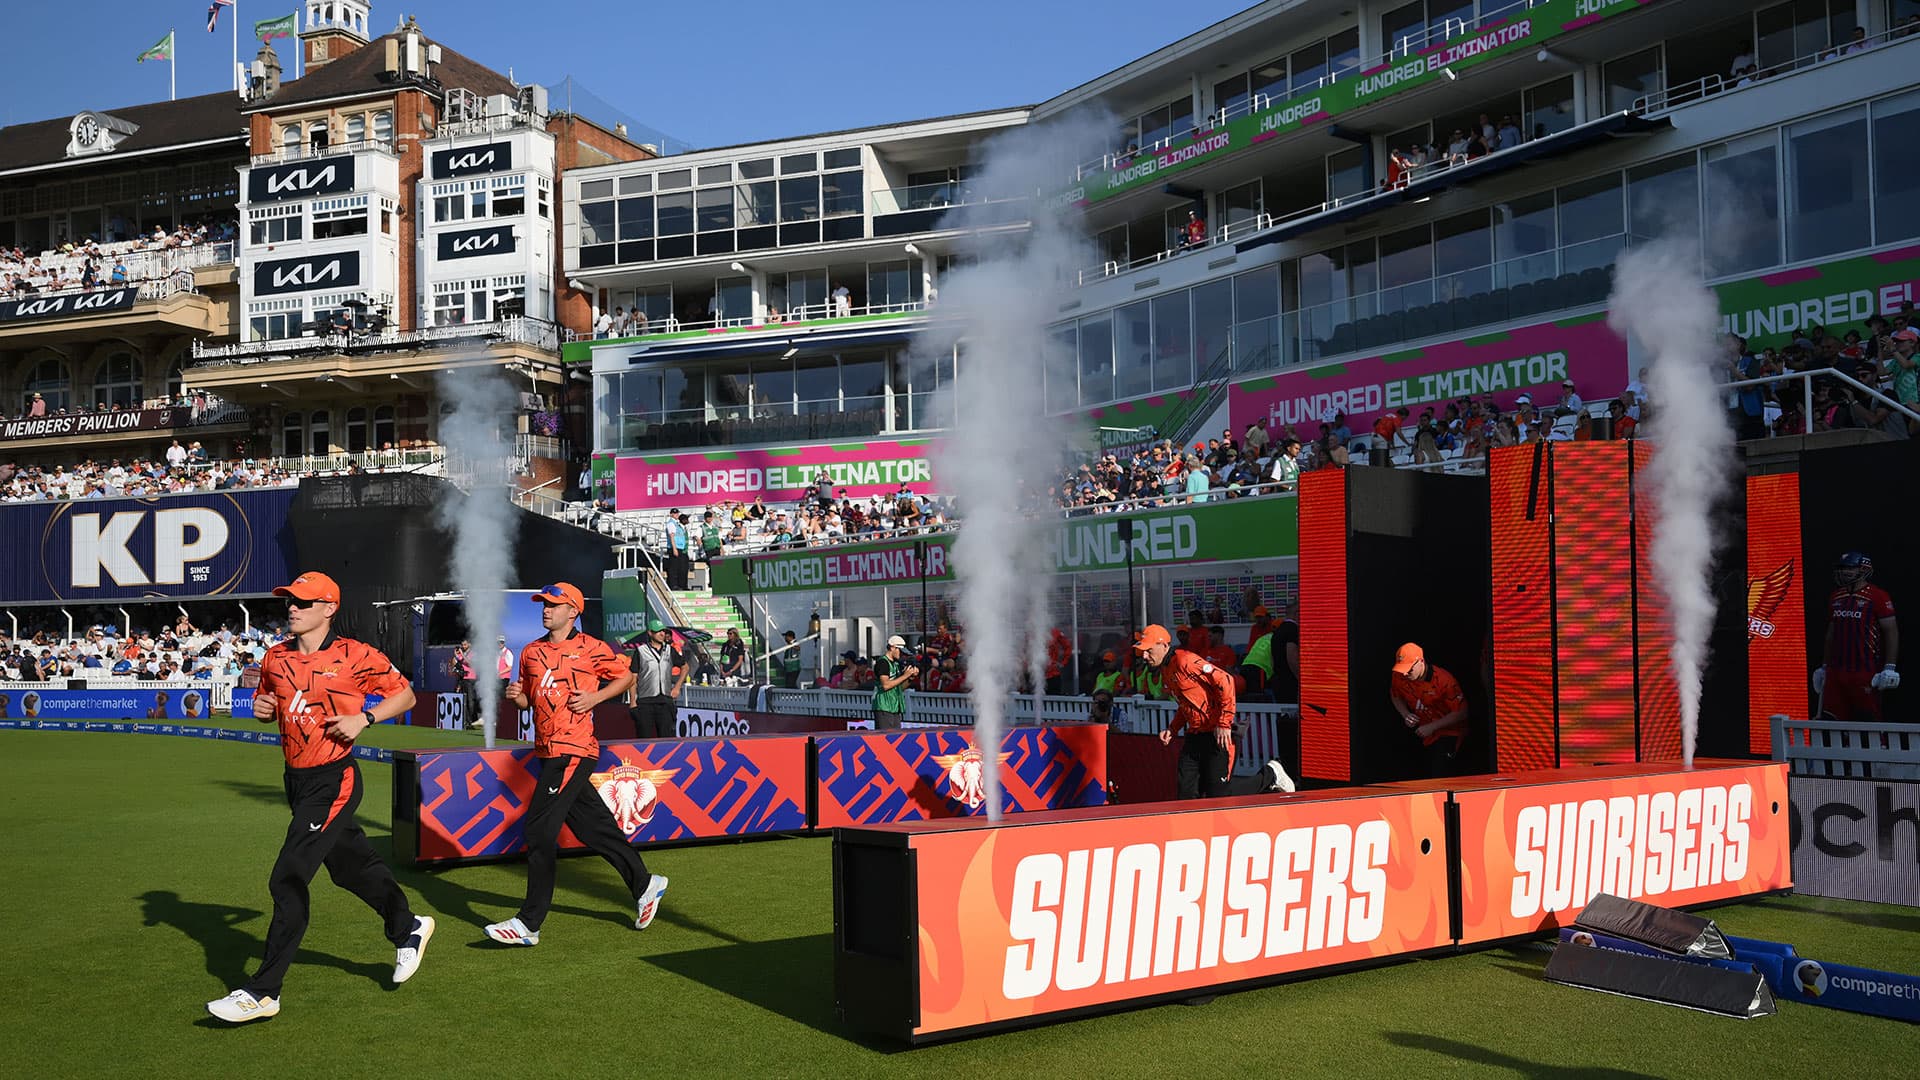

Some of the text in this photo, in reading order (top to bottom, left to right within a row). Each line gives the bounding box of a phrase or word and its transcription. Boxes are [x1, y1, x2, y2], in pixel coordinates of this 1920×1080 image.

[1354, 19, 1531, 98] HUNDRED ELIMINATOR
[1260, 97, 1321, 132] HUNDRED
[1108, 132, 1229, 189] HUNDRED ELIMINATOR
[1270, 352, 1567, 428] HUNDRED ELIMINATOR
[77, 412, 141, 431] PAVILION
[648, 468, 763, 496] HUNDRED
[766, 458, 931, 490] ELIMINATOR
[71, 507, 229, 588] KP
[1051, 515, 1198, 568] HUNDRED
[190, 566, 210, 574] SINCE
[192, 574, 208, 582] 1953
[752, 557, 822, 588] HUNDRED
[43, 698, 138, 711] comparethemarket
[537, 689, 561, 697] APEX
[285, 714, 317, 725] APEX
[1510, 783, 1752, 918] SUNRISERS
[1002, 820, 1390, 1000] SUNRISERS
